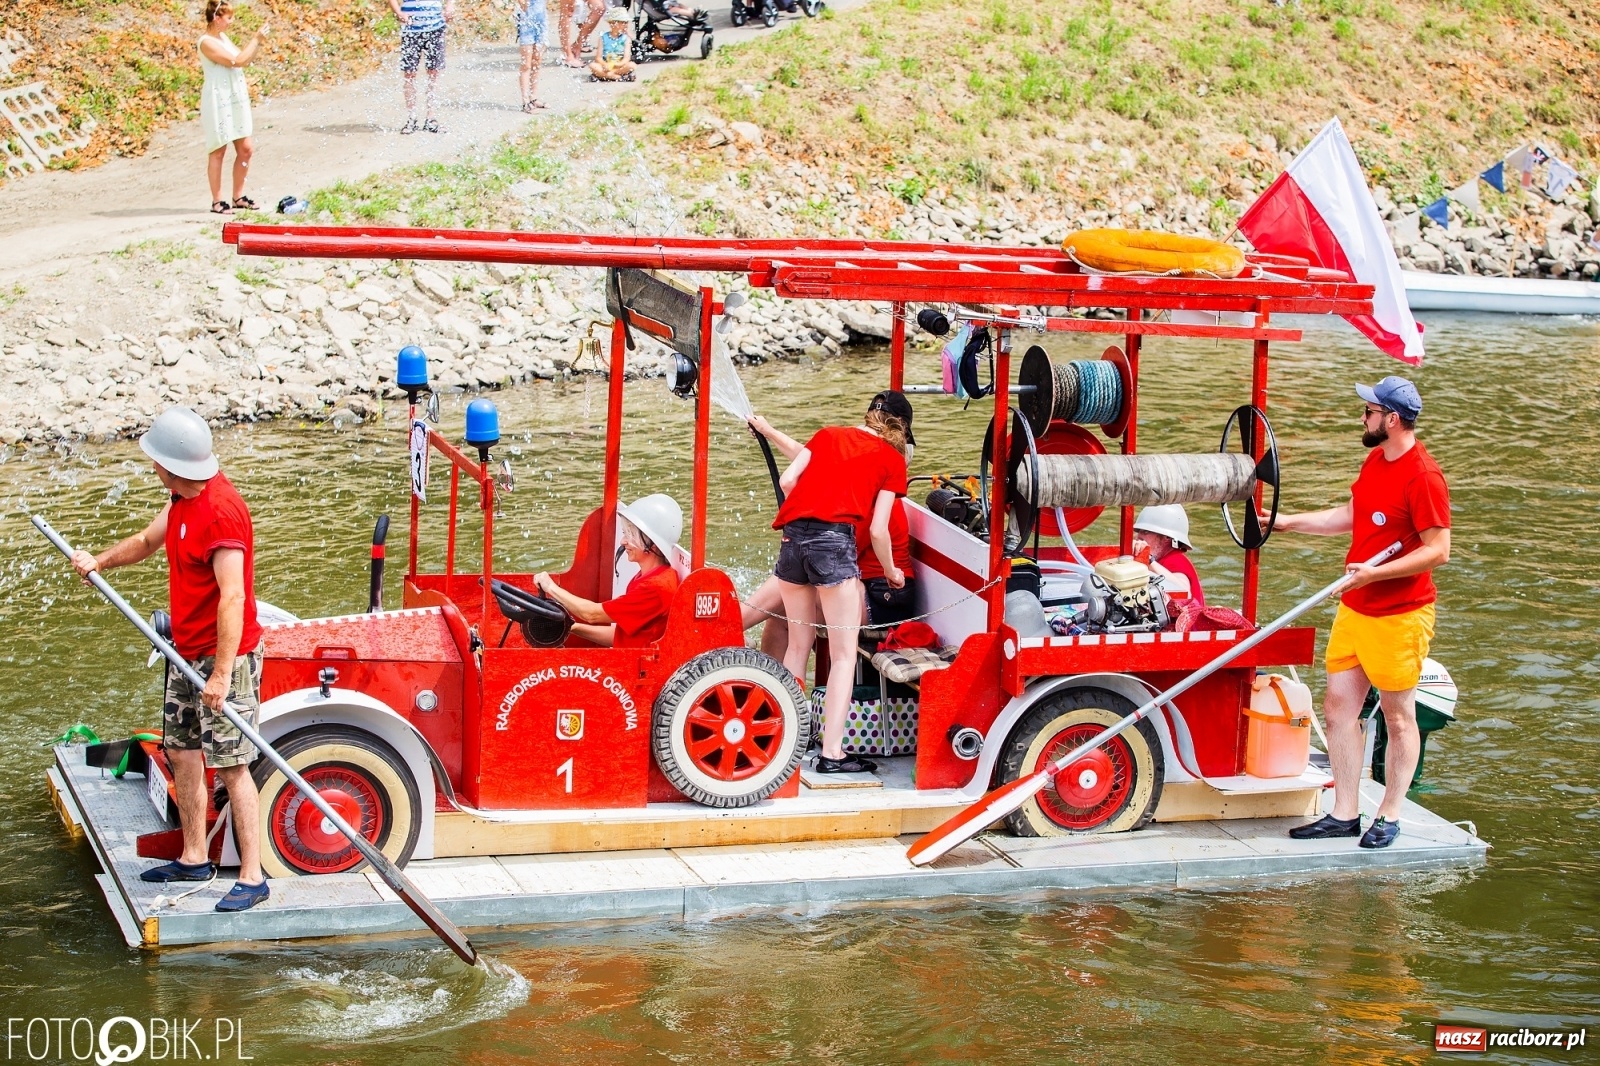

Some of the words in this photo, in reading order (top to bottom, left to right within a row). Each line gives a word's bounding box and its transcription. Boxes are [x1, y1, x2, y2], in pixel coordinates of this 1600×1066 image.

[696, 595, 713, 616] 998
[495, 667, 557, 731] RACIBORSKA
[559, 665, 602, 683] STRAŻ
[602, 676, 638, 731] OGNIOWA
[556, 756, 574, 794] 1
